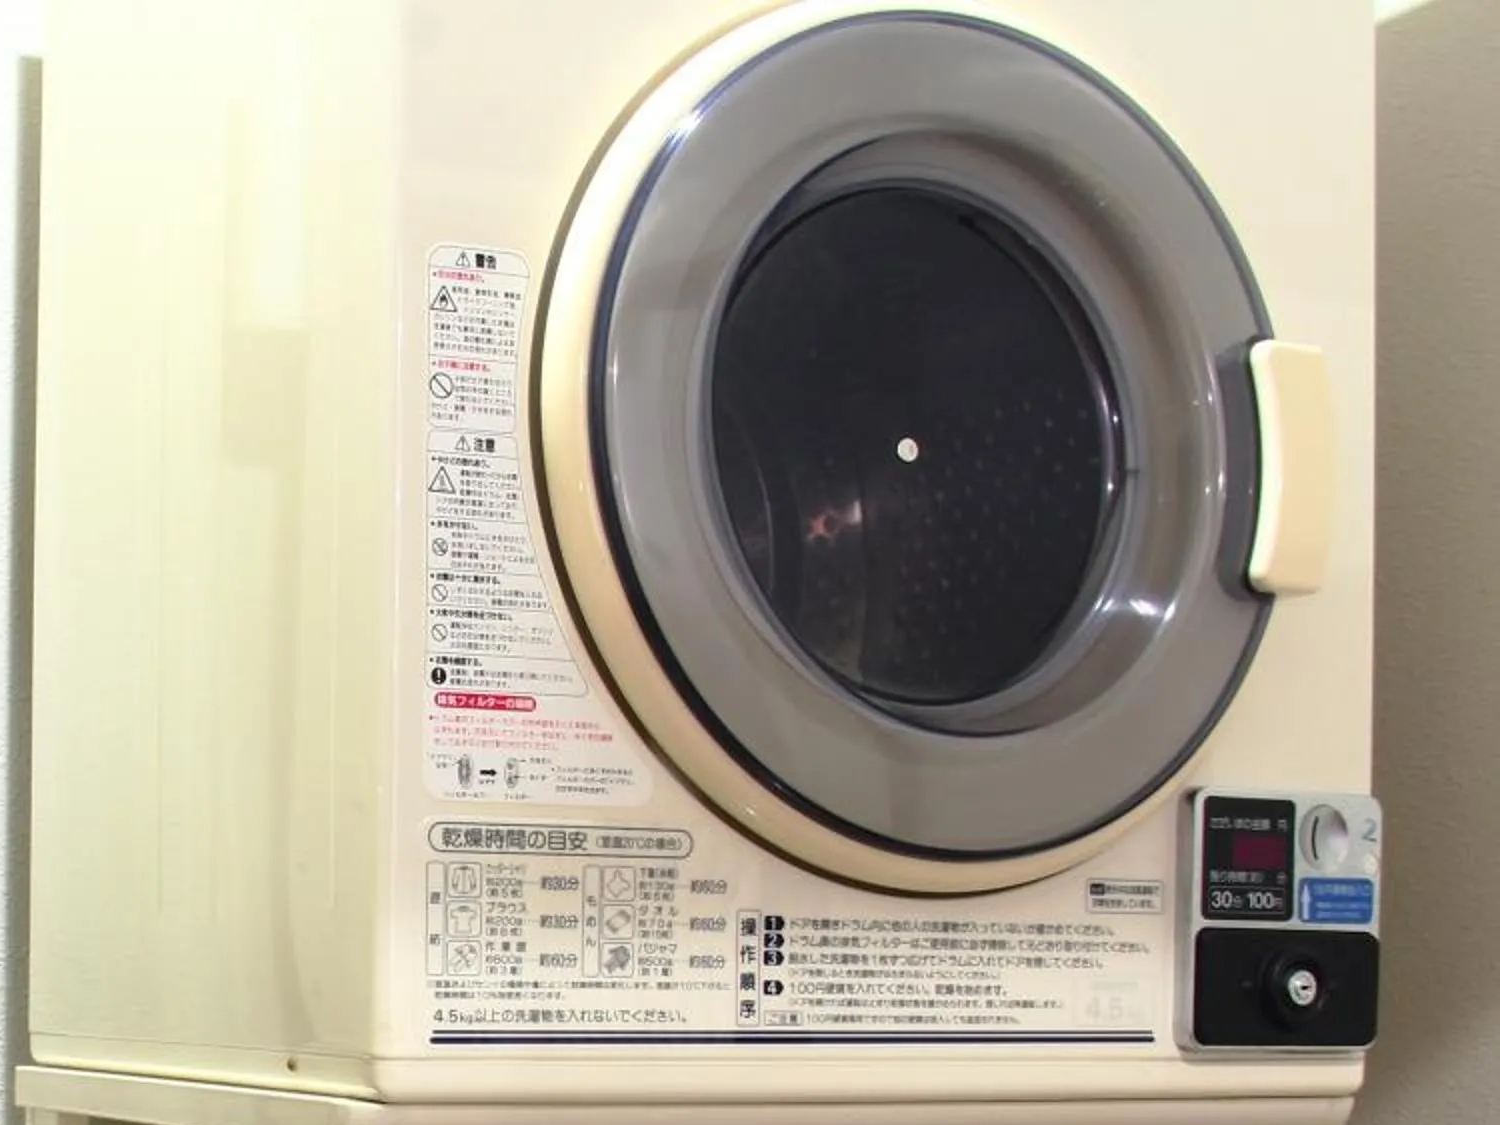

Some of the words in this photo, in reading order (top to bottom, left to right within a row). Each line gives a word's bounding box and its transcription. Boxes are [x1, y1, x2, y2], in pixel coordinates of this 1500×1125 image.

[473, 437, 496, 453] 注意
[441, 827, 588, 852] 乾燥時間の目安
[1361, 817, 1378, 843] 2
[432, 1009, 688, 1025] 4.5kg以上の洗濯物を入れないでください。
